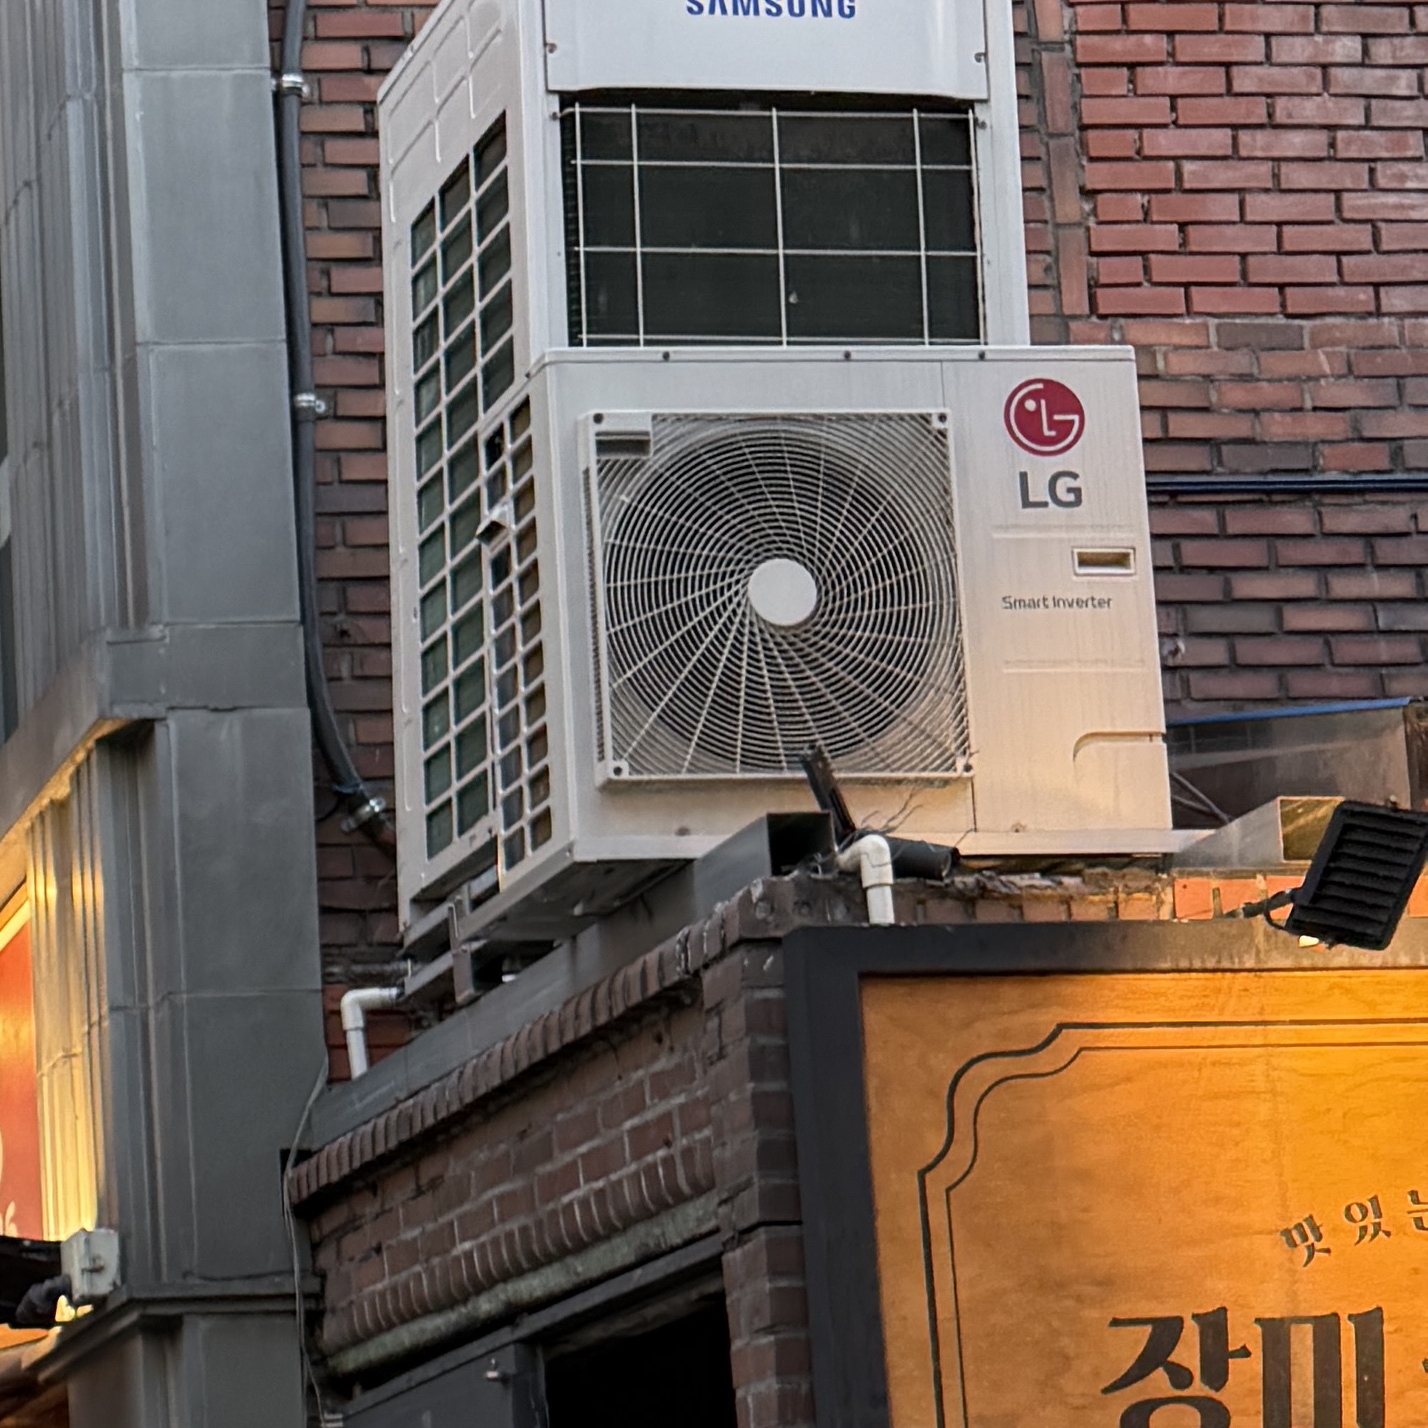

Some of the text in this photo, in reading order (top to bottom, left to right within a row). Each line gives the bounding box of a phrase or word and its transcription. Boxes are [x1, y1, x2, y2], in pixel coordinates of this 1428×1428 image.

[1019, 470, 1083, 509] LG
[1001, 595, 1112, 610] Smart Inverter
